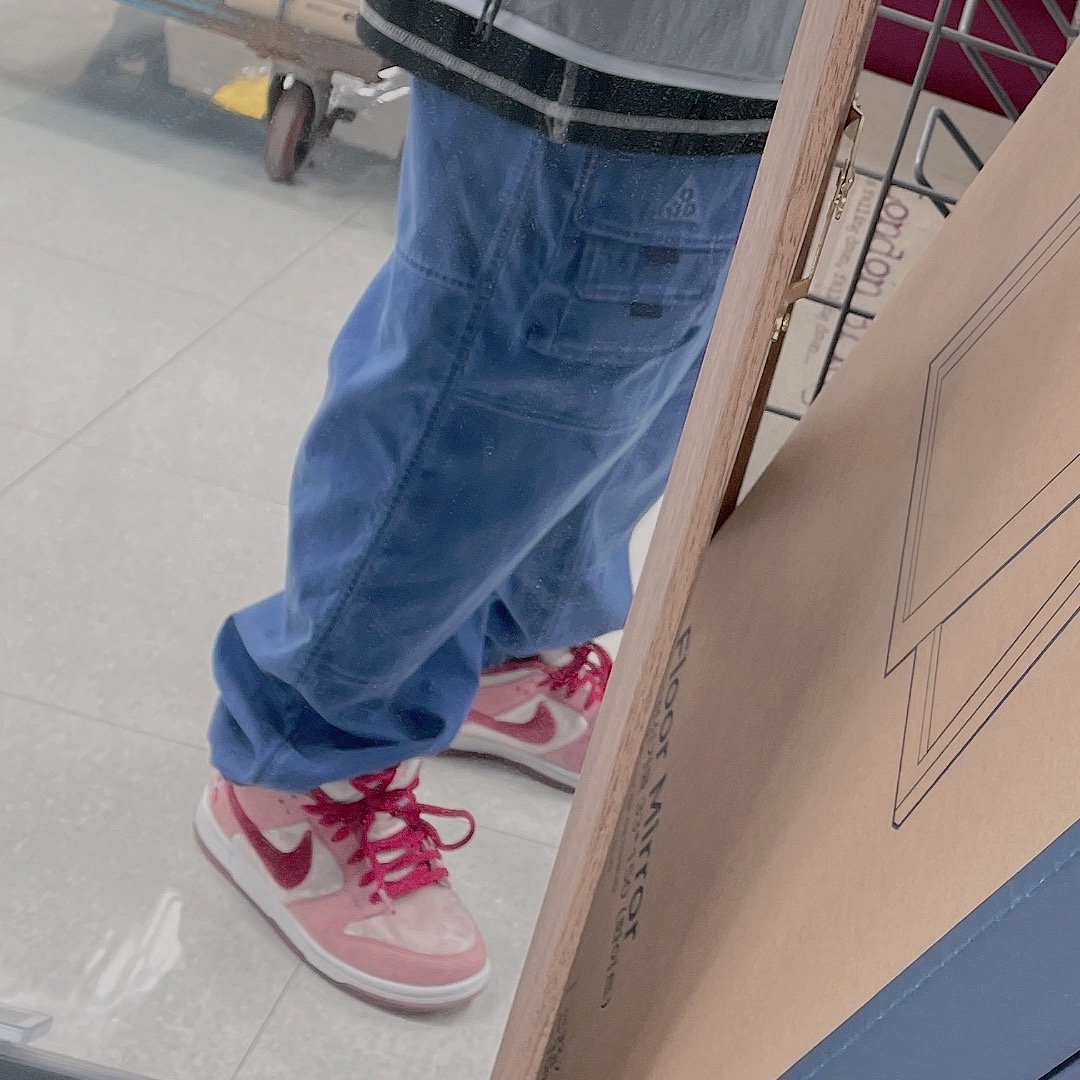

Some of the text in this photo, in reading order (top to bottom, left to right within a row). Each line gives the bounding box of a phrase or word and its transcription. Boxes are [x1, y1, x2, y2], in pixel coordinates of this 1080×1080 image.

[855, 186, 910, 298] ondon
[655, 625, 692, 760] Floor
[624, 774, 668, 942] Mirror
